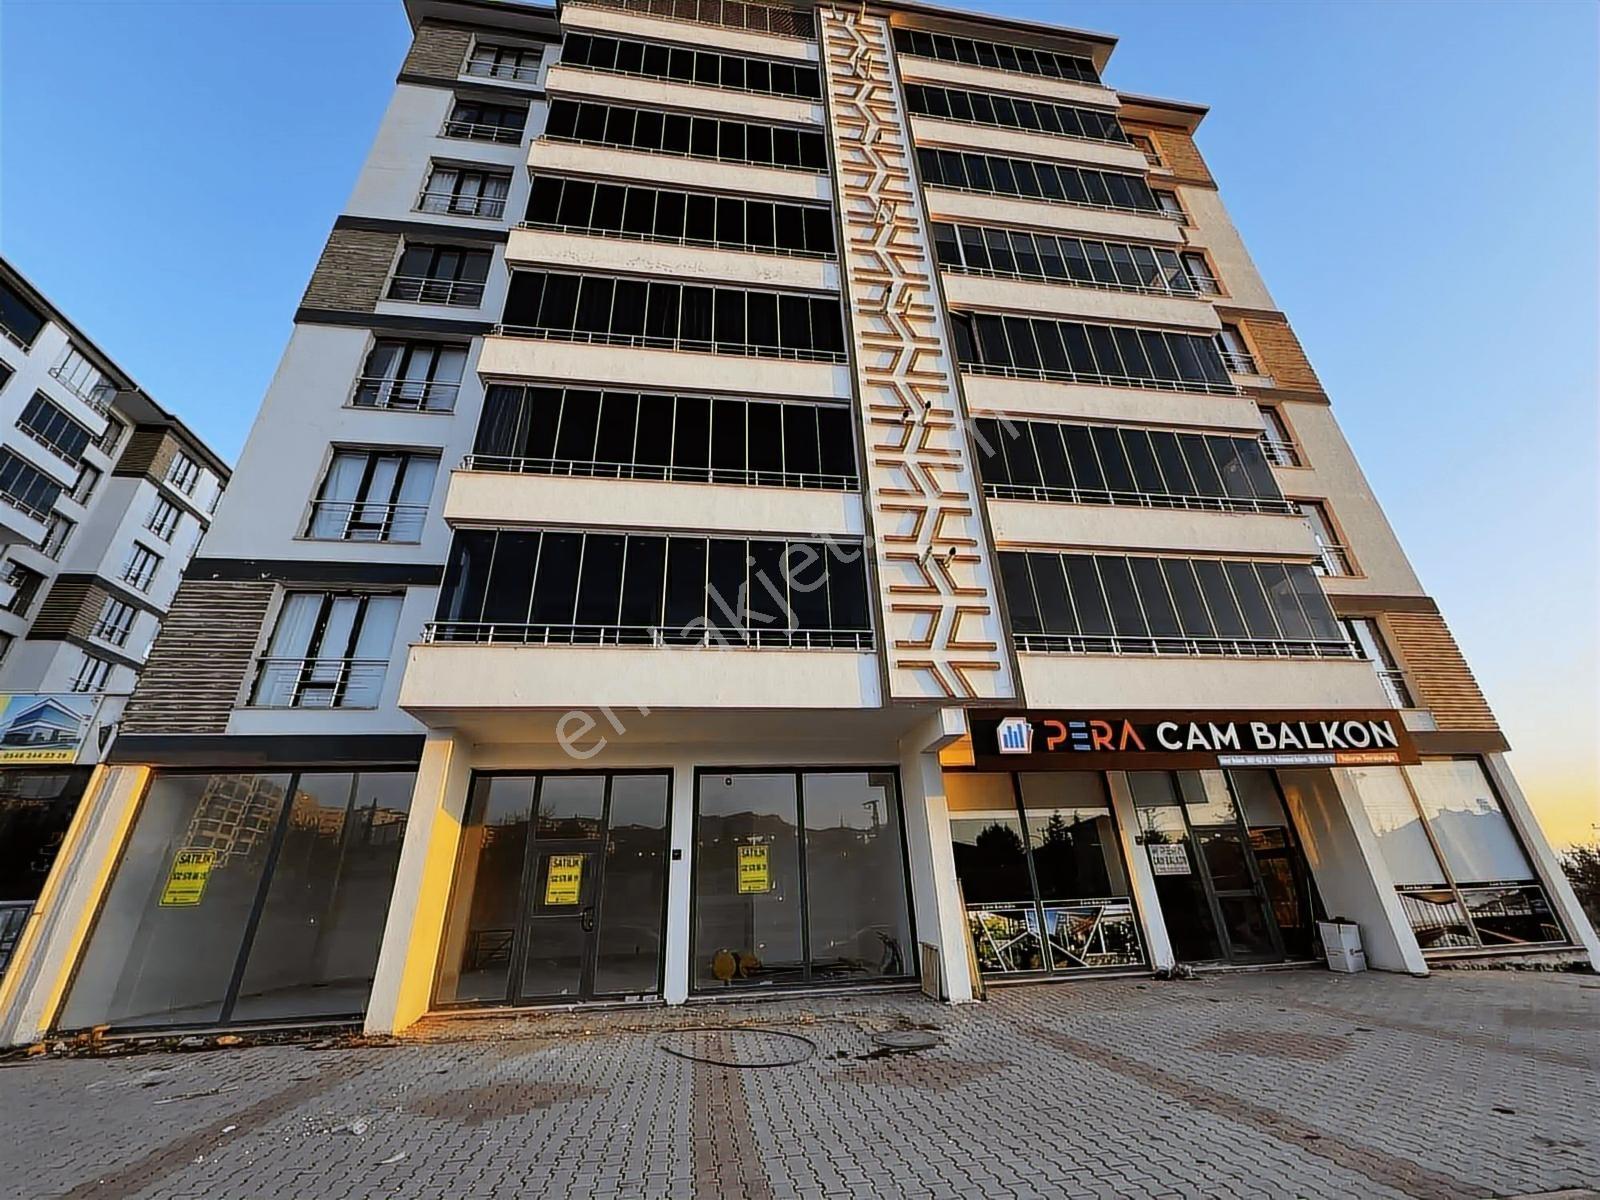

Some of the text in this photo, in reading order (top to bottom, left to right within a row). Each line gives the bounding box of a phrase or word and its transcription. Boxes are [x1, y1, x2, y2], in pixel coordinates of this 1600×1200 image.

[1043, 719, 1399, 750] PERA CAM BALKON
